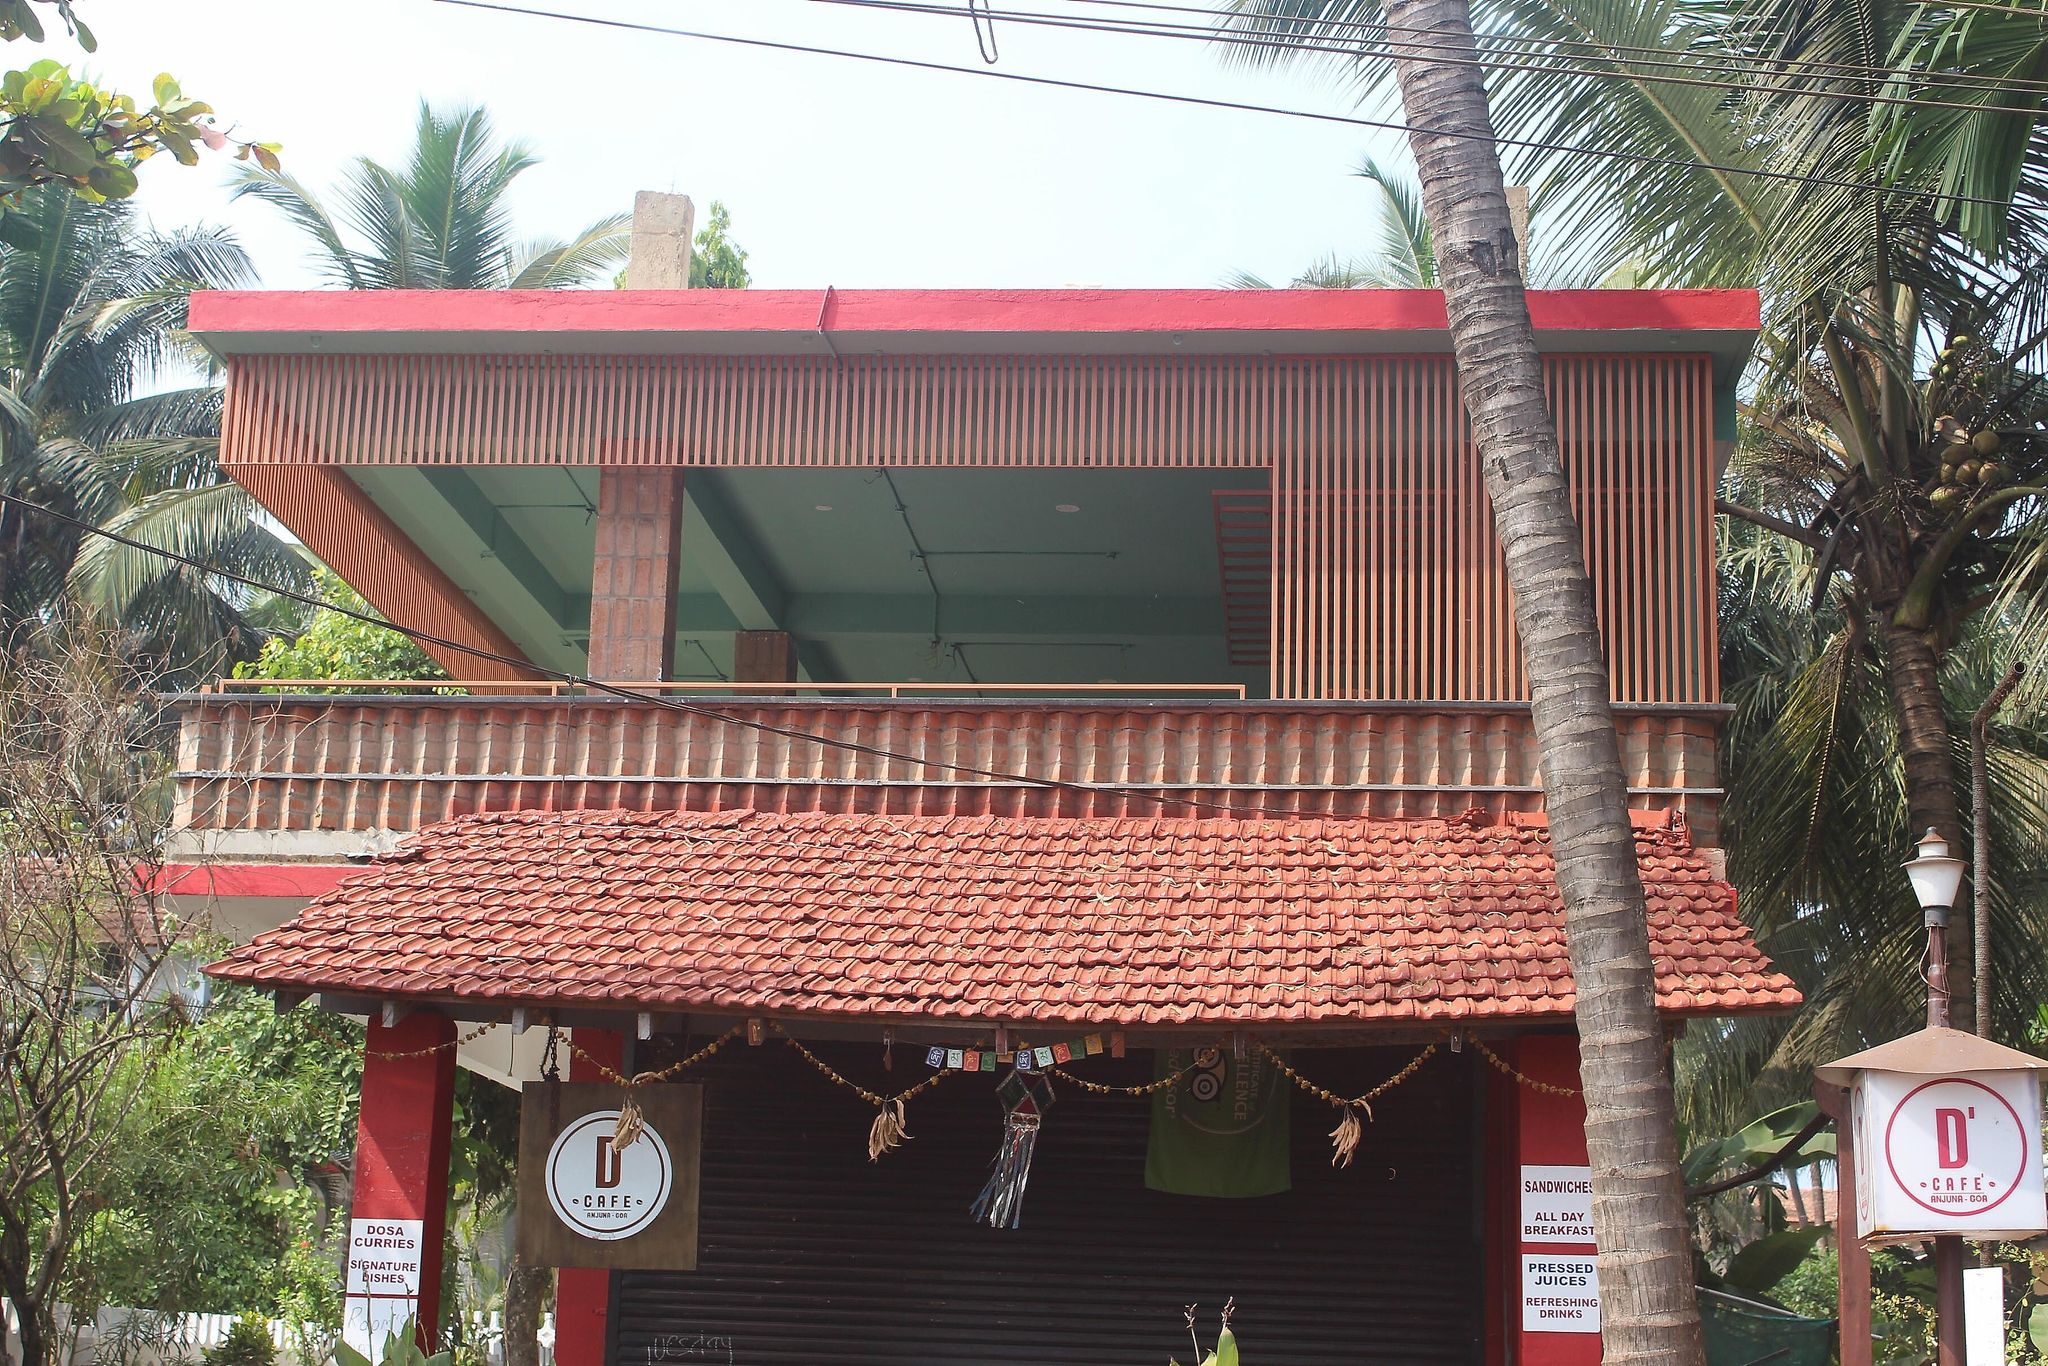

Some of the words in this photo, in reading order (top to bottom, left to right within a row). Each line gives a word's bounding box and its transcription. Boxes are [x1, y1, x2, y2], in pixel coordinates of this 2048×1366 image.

[584, 1195, 631, 1208] CAFE
[1931, 1195, 1963, 1204] ANJUNA
[1970, 1195, 1988, 1203] GOA
[1535, 1212, 1558, 1222] ALL
[1561, 1212, 1585, 1222] DAY
[367, 1225, 404, 1236] DOSA
[1524, 1225, 1594, 1236] BREAKFAST
[354, 1237, 415, 1249] CURRIES
[350, 1259, 417, 1272] SIGNATURE
[1528, 1263, 1594, 1274] PRESSED
[362, 1273, 404, 1284] DISHES
[1534, 1275, 1587, 1286] JUICES
[1526, 1297, 1598, 1308] REFRESHING
[1539, 1309, 1583, 1319] DRINKS
